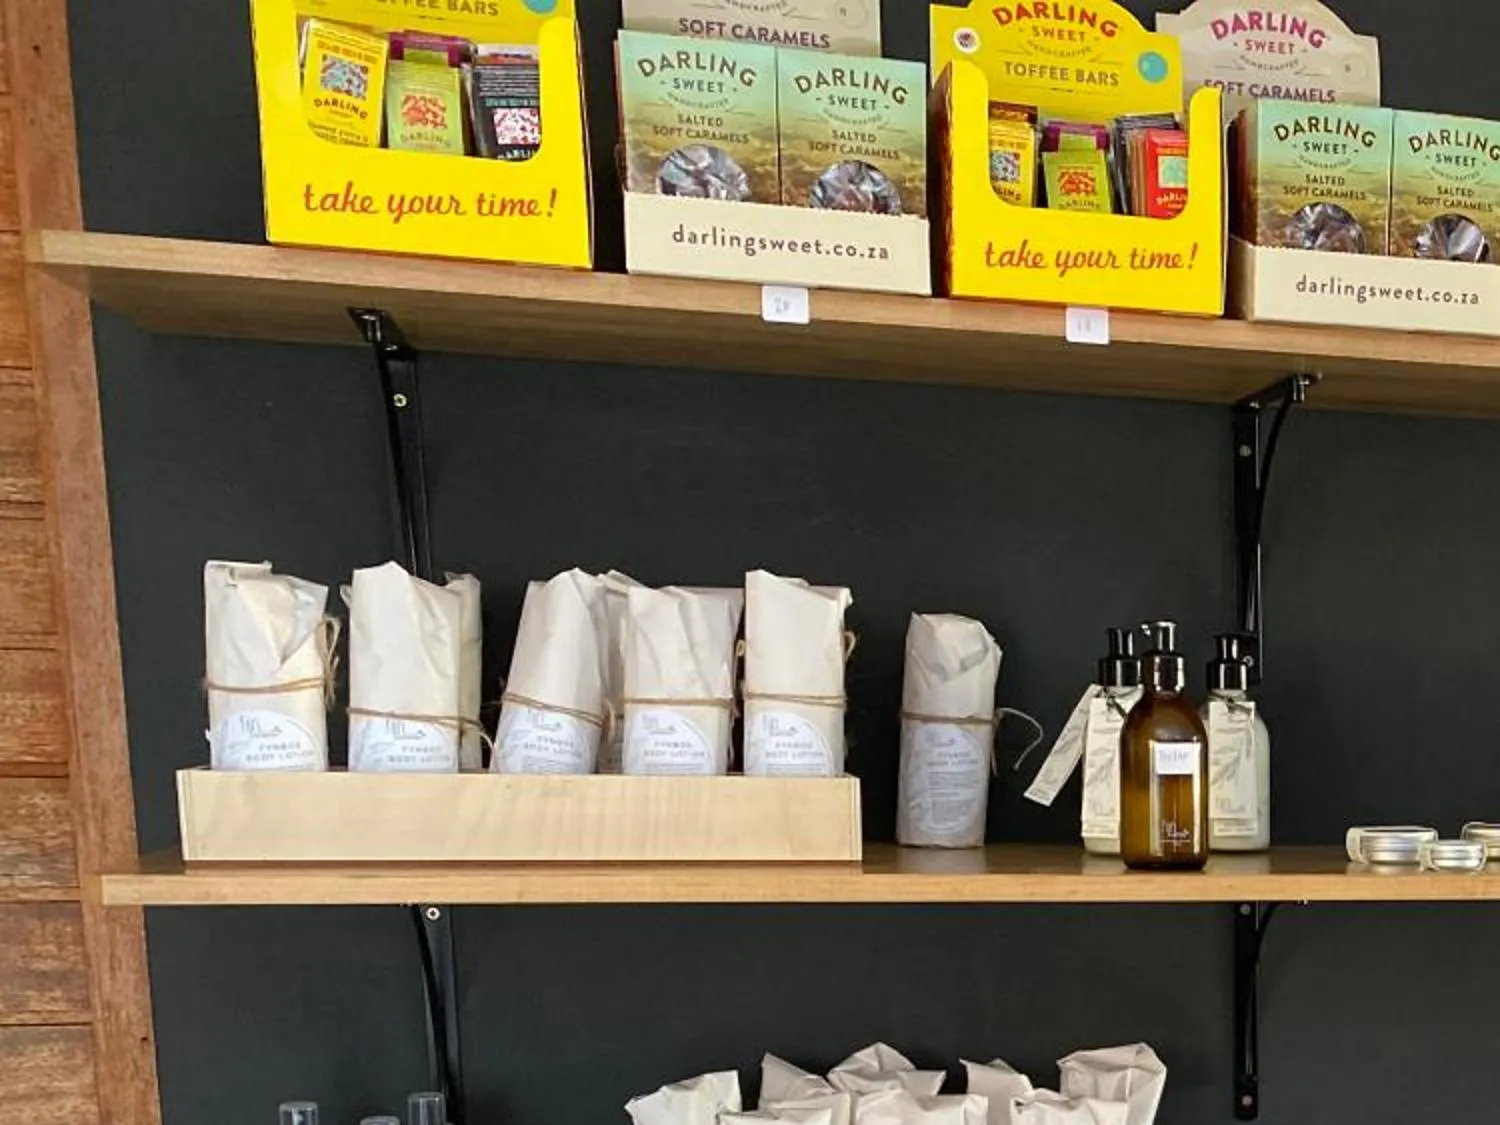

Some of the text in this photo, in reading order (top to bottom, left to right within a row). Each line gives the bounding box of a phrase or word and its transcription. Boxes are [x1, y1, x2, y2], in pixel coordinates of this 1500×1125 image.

[447, 0, 499, 16] BARS
[992, 1, 1119, 38] DARLING
[679, 18, 831, 48] SOFT CARAMELS
[1032, 26, 1086, 42] SWEET
[1210, 11, 1326, 49] DARLING
[1245, 39, 1295, 55] SWEET
[638, 51, 757, 87] DARLING
[1004, 61, 1120, 86] TOFFEE BARS
[673, 78, 724, 94] SWEET
[795, 68, 909, 105] DARLING
[1249, 83, 1336, 104] CARAMELS
[313, 97, 369, 120] DARLING
[829, 94, 877, 111] SWEET
[677, 114, 724, 127] SALTED
[1273, 116, 1376, 148] DARLING
[832, 129, 877, 143] SALTED
[1303, 141, 1347, 155] SWEET
[1435, 153, 1477, 167] SWEET
[1305, 173, 1345, 186] SALTED
[304, 181, 558, 224] take your time!
[672, 224, 889, 260] darlingsweet.co.za
[985, 240, 1198, 277] take your time!
[1296, 275, 1479, 305] darlingsweet.co.za
